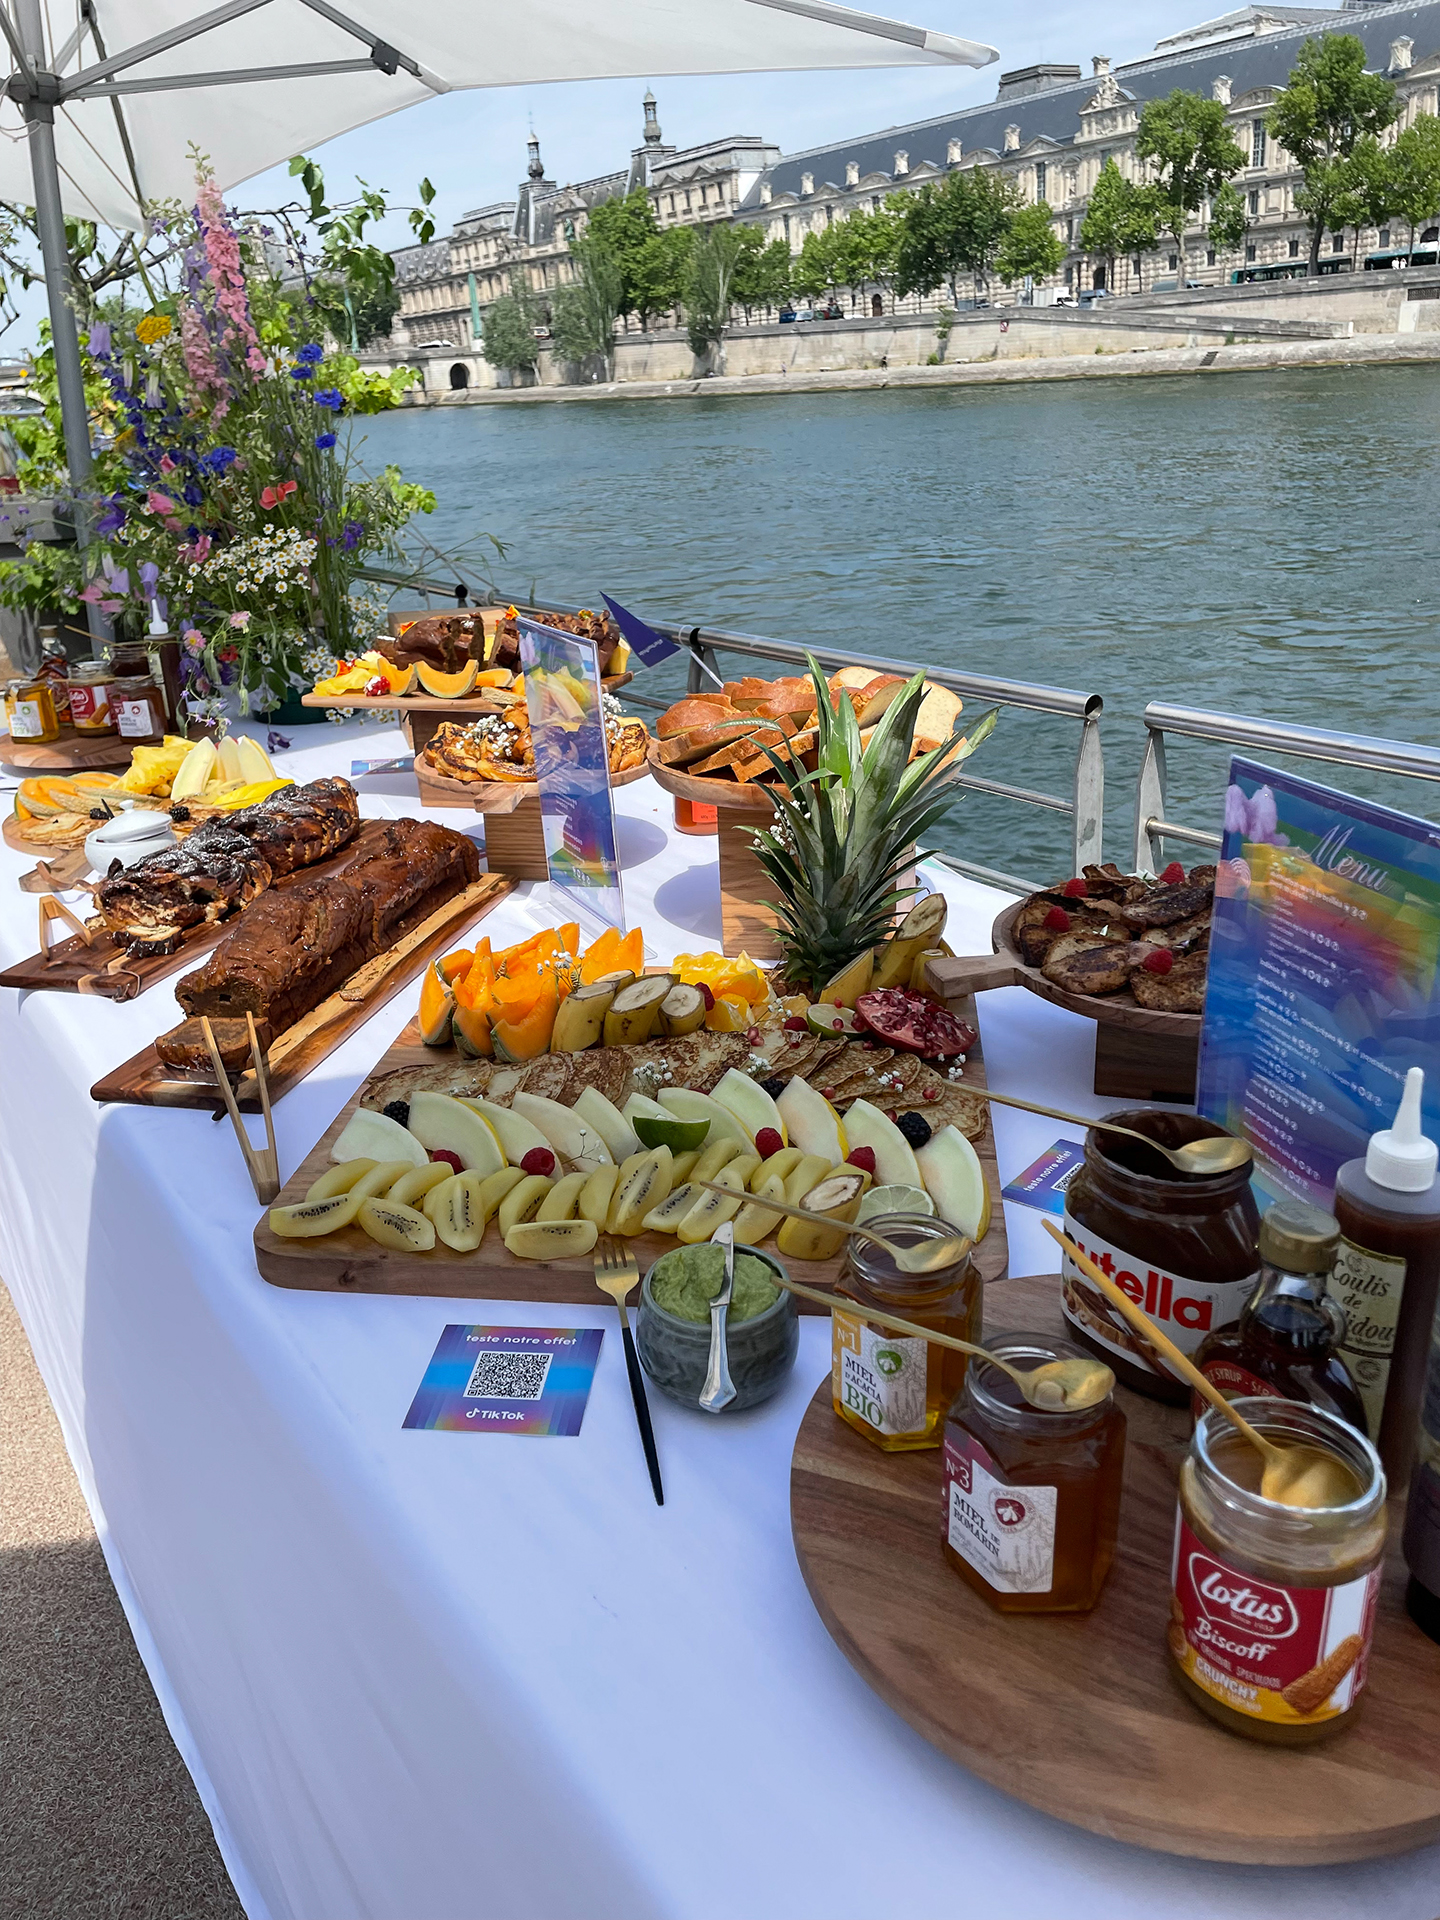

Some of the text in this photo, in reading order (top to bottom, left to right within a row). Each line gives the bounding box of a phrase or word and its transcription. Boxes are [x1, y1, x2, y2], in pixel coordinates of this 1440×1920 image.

[1303, 824, 1392, 892] Menu
[1022, 1150, 1073, 1192] teste notre effet
[1332, 1259, 1391, 1297] Coulis
[1342, 1293, 1362, 1310] de
[466, 1334, 578, 1346] teste notre effet
[846, 1355, 876, 1388] MIEL
[1215, 1368, 1242, 1383] SYRUP
[481, 1409, 525, 1421] TikTok
[845, 1382, 884, 1427] BIO
[953, 1507, 1000, 1558] ROMARIN
[954, 1492, 988, 1534] MIEL
[990, 1532, 1000, 1546] DE
[1200, 1572, 1284, 1624] Lotus
[1195, 1616, 1277, 1662] Biscoff
[1196, 1657, 1258, 1700] CRUNCHY
